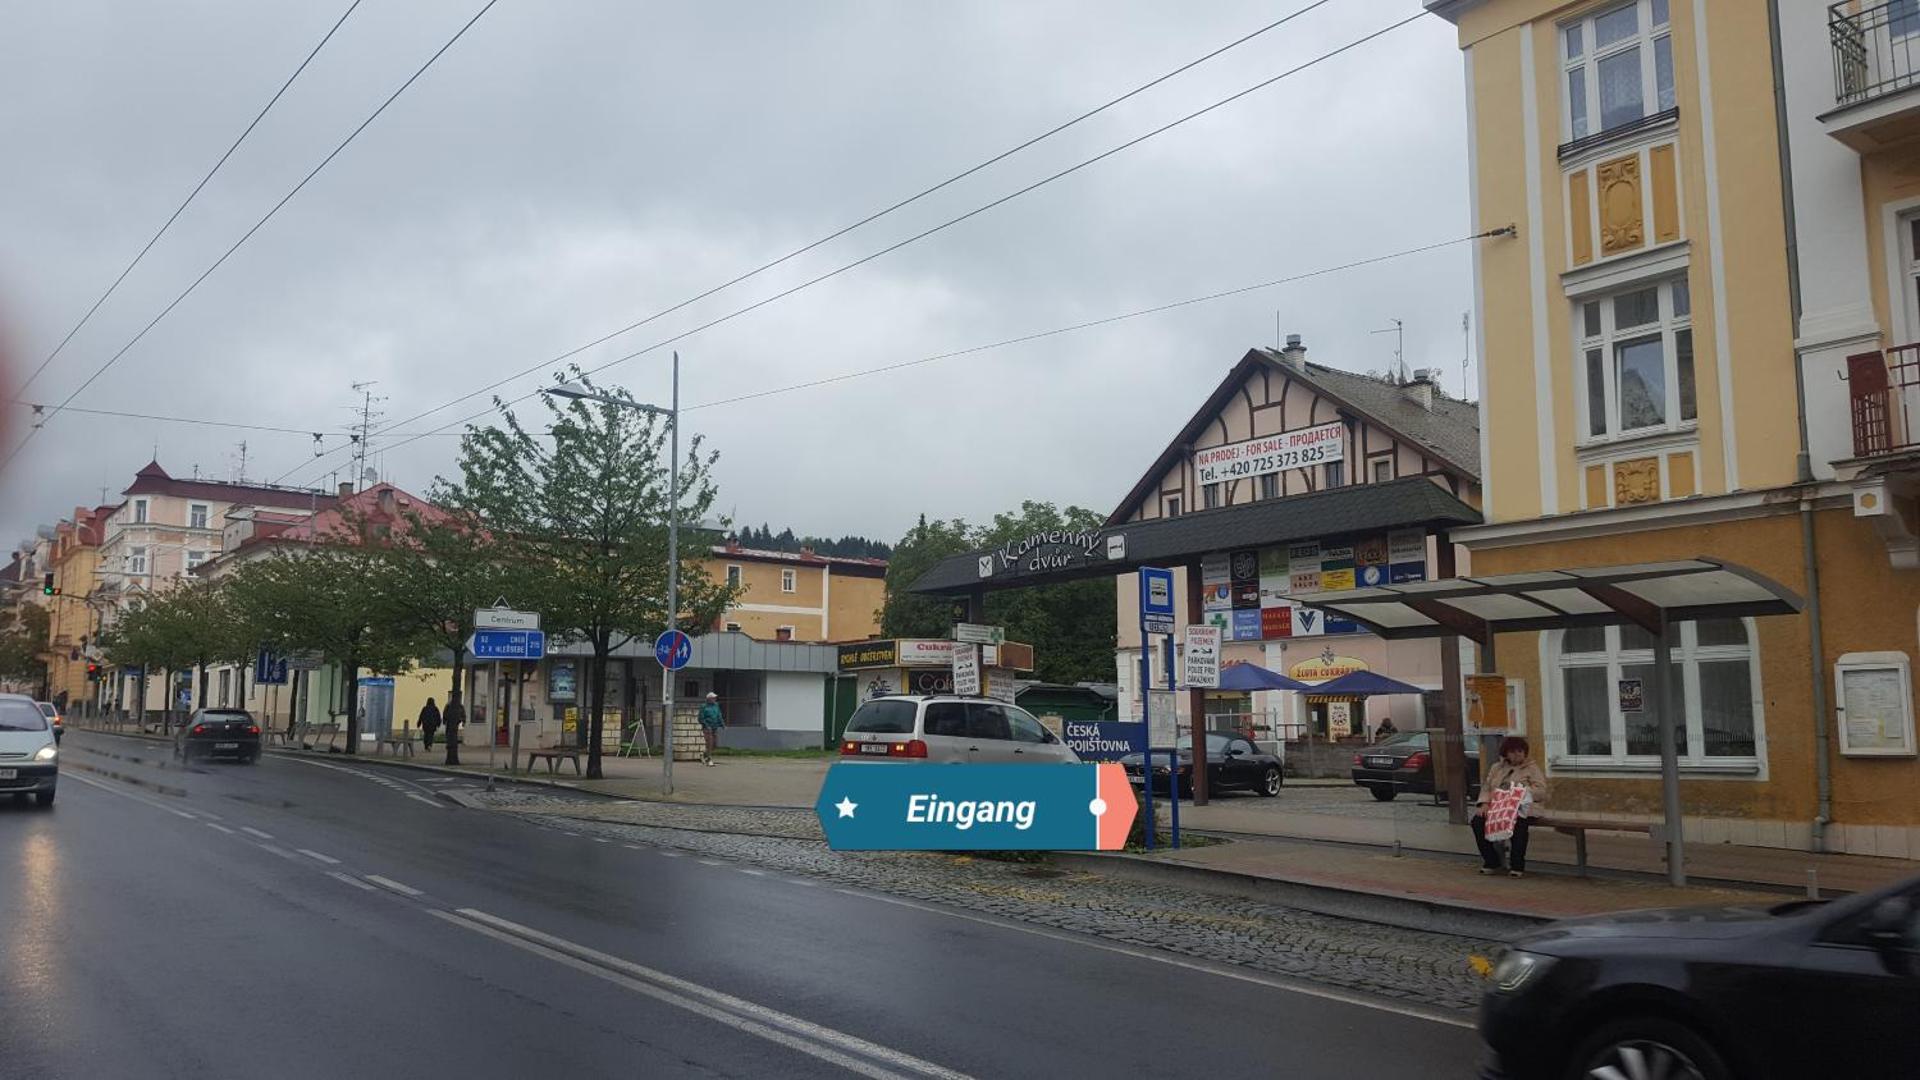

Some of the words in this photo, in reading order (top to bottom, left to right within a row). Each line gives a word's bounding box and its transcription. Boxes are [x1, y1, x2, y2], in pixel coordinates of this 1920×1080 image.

[1199, 452, 1210, 466] NA
[1210, 445, 1240, 462] PRODEJ
[1246, 443, 1262, 457] FOR
[1263, 438, 1283, 453] SALE
[1289, 425, 1341, 447] ПРОДАЕТСЯ
[1200, 466, 1218, 482] Tel.
[1220, 460, 1250, 478] +420
[1253, 455, 1274, 471] 725
[1277, 451, 1299, 467] 373
[1301, 446, 1324, 463] 825
[490, 615, 525, 625] Centrum
[1066, 721, 1101, 737] ČESKÁ
[1067, 737, 1131, 753] POJIŠŤOVNA
